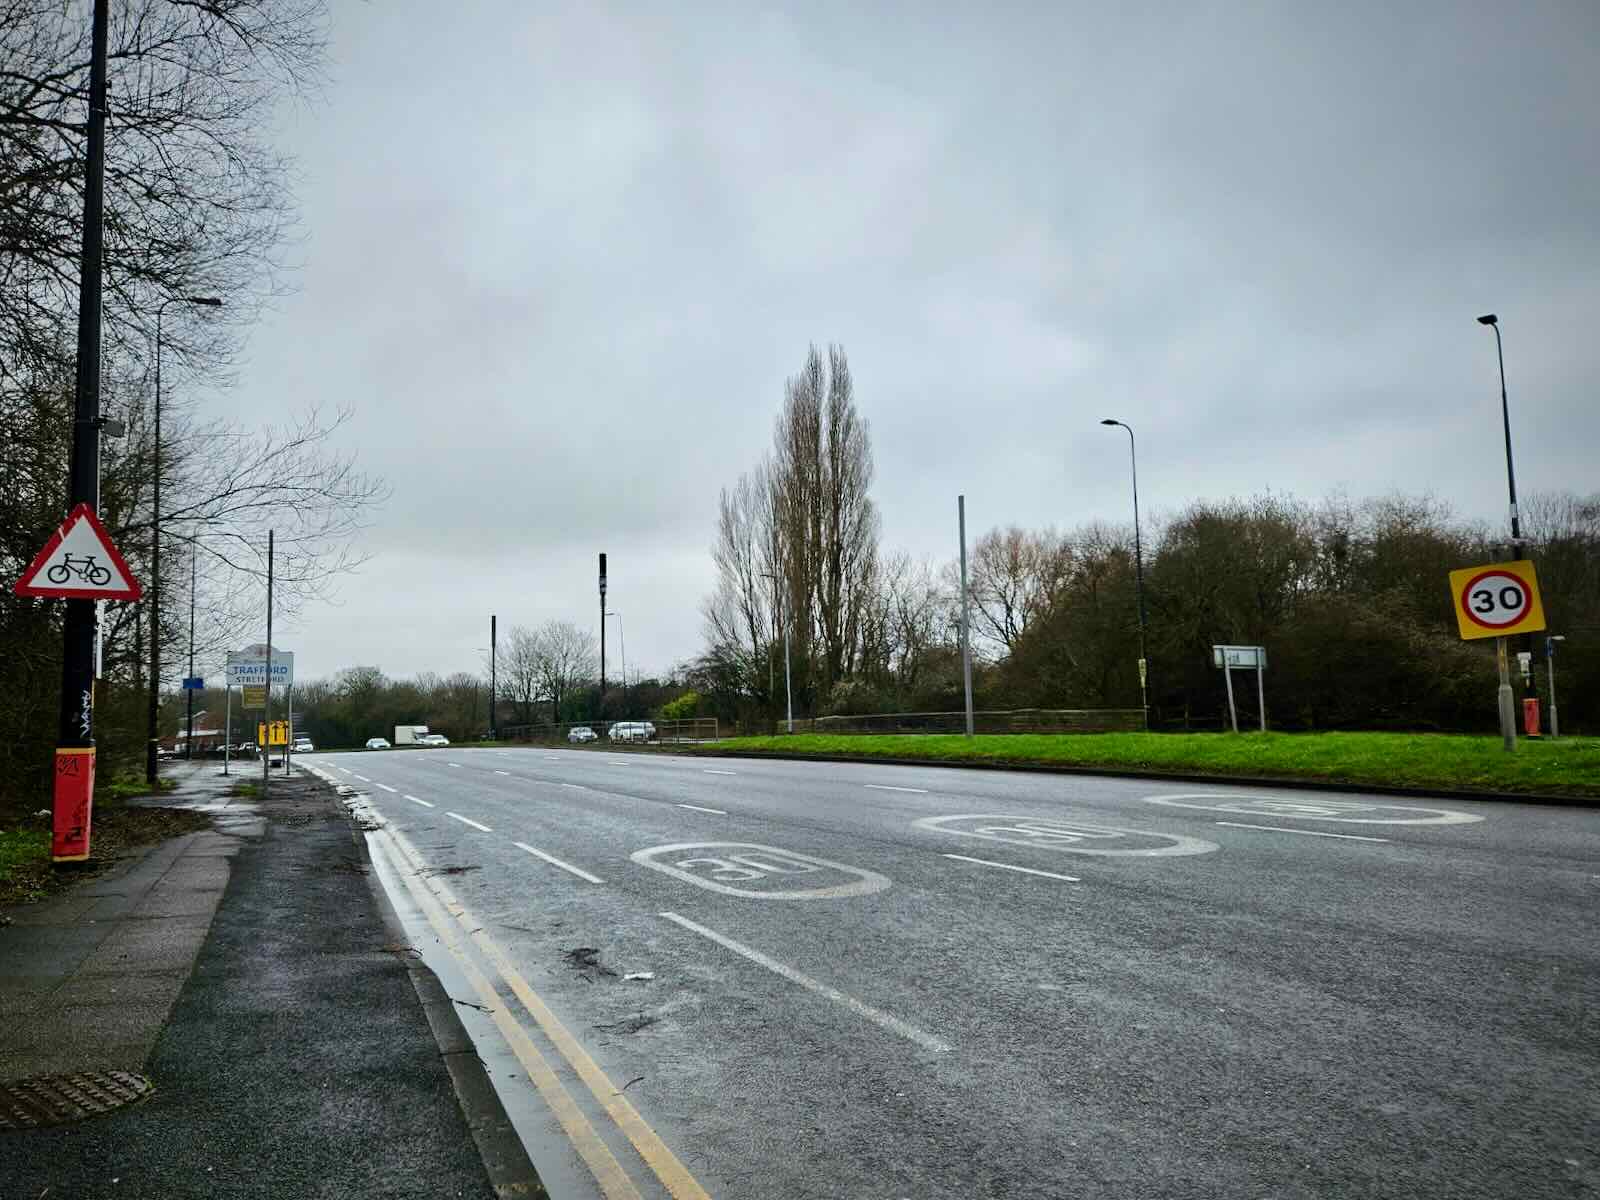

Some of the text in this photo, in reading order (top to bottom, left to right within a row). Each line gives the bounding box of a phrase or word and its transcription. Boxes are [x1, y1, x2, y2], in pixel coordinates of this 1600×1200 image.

[1473, 586, 1523, 613] 30
[976, 823, 1126, 843] 30
[675, 852, 824, 881] 30
